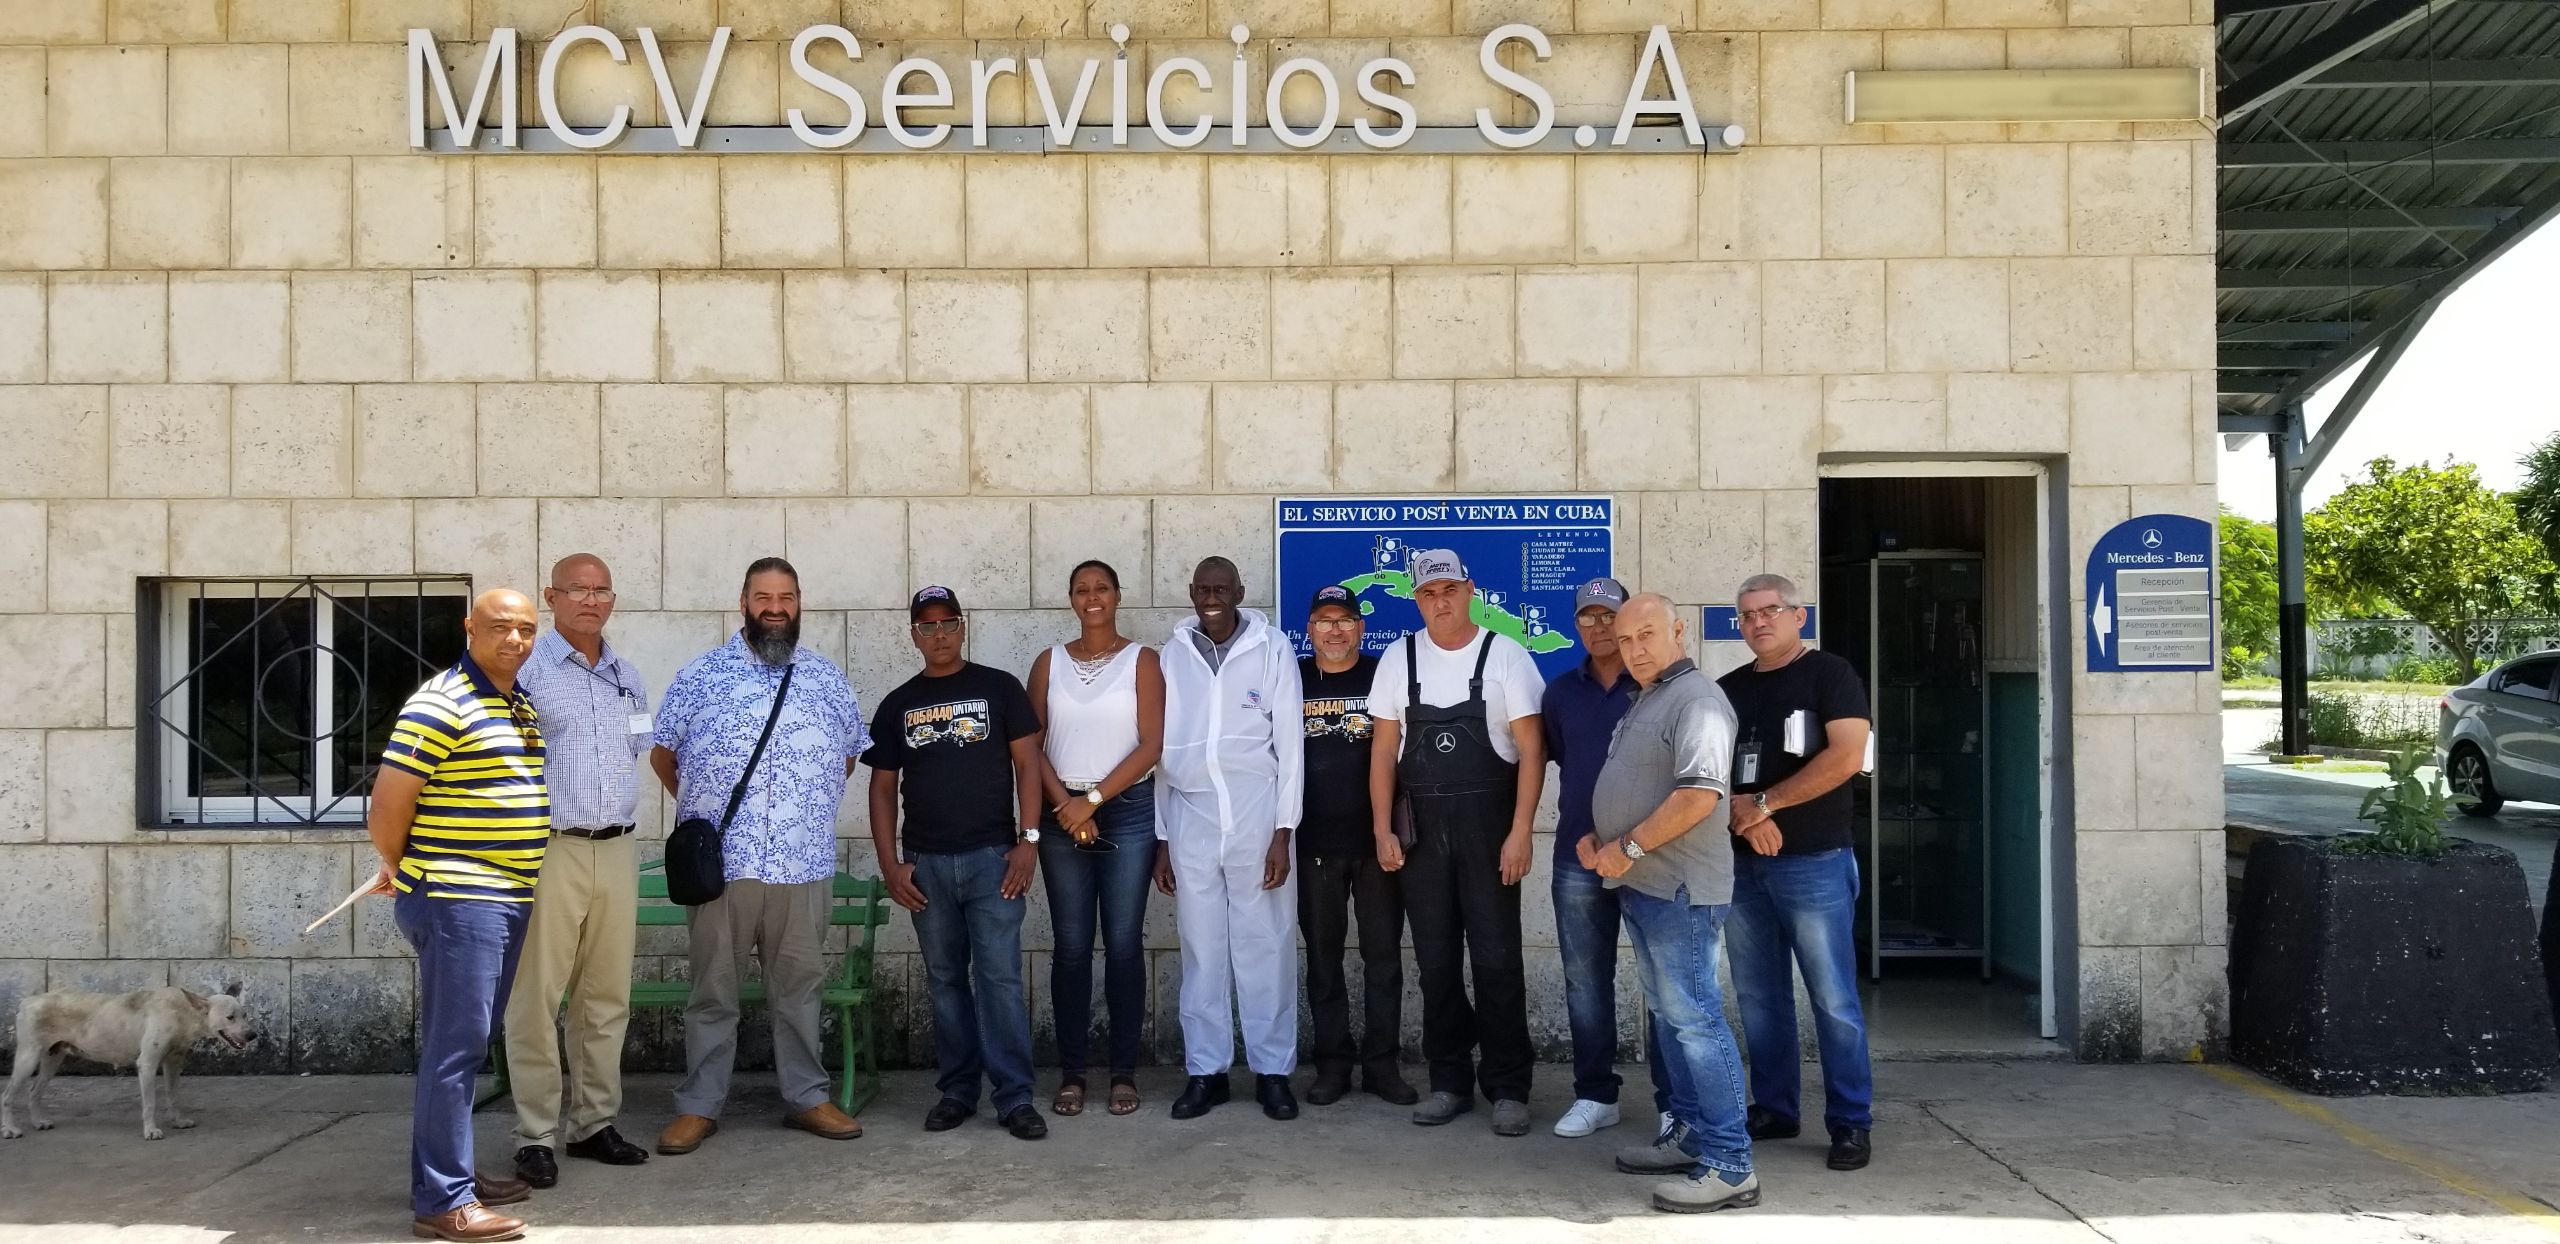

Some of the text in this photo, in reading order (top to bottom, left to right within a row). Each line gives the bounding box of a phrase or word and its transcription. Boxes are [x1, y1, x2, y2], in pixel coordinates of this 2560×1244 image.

[408, 22, 1746, 149] MCV Servicios S.A.
[1283, 505, 1607, 522] EL SERVICIO POST VENTA EN CUBA
[2107, 551, 2164, 564] Mercedes
[2174, 551, 2204, 563] Benz
[2141, 577, 2184, 588] Recepción
[1287, 630, 1302, 640] Un
[1362, 630, 1397, 640] ervicio
[952, 701, 985, 716] ONTARIO
[1303, 700, 1345, 716] 058440
